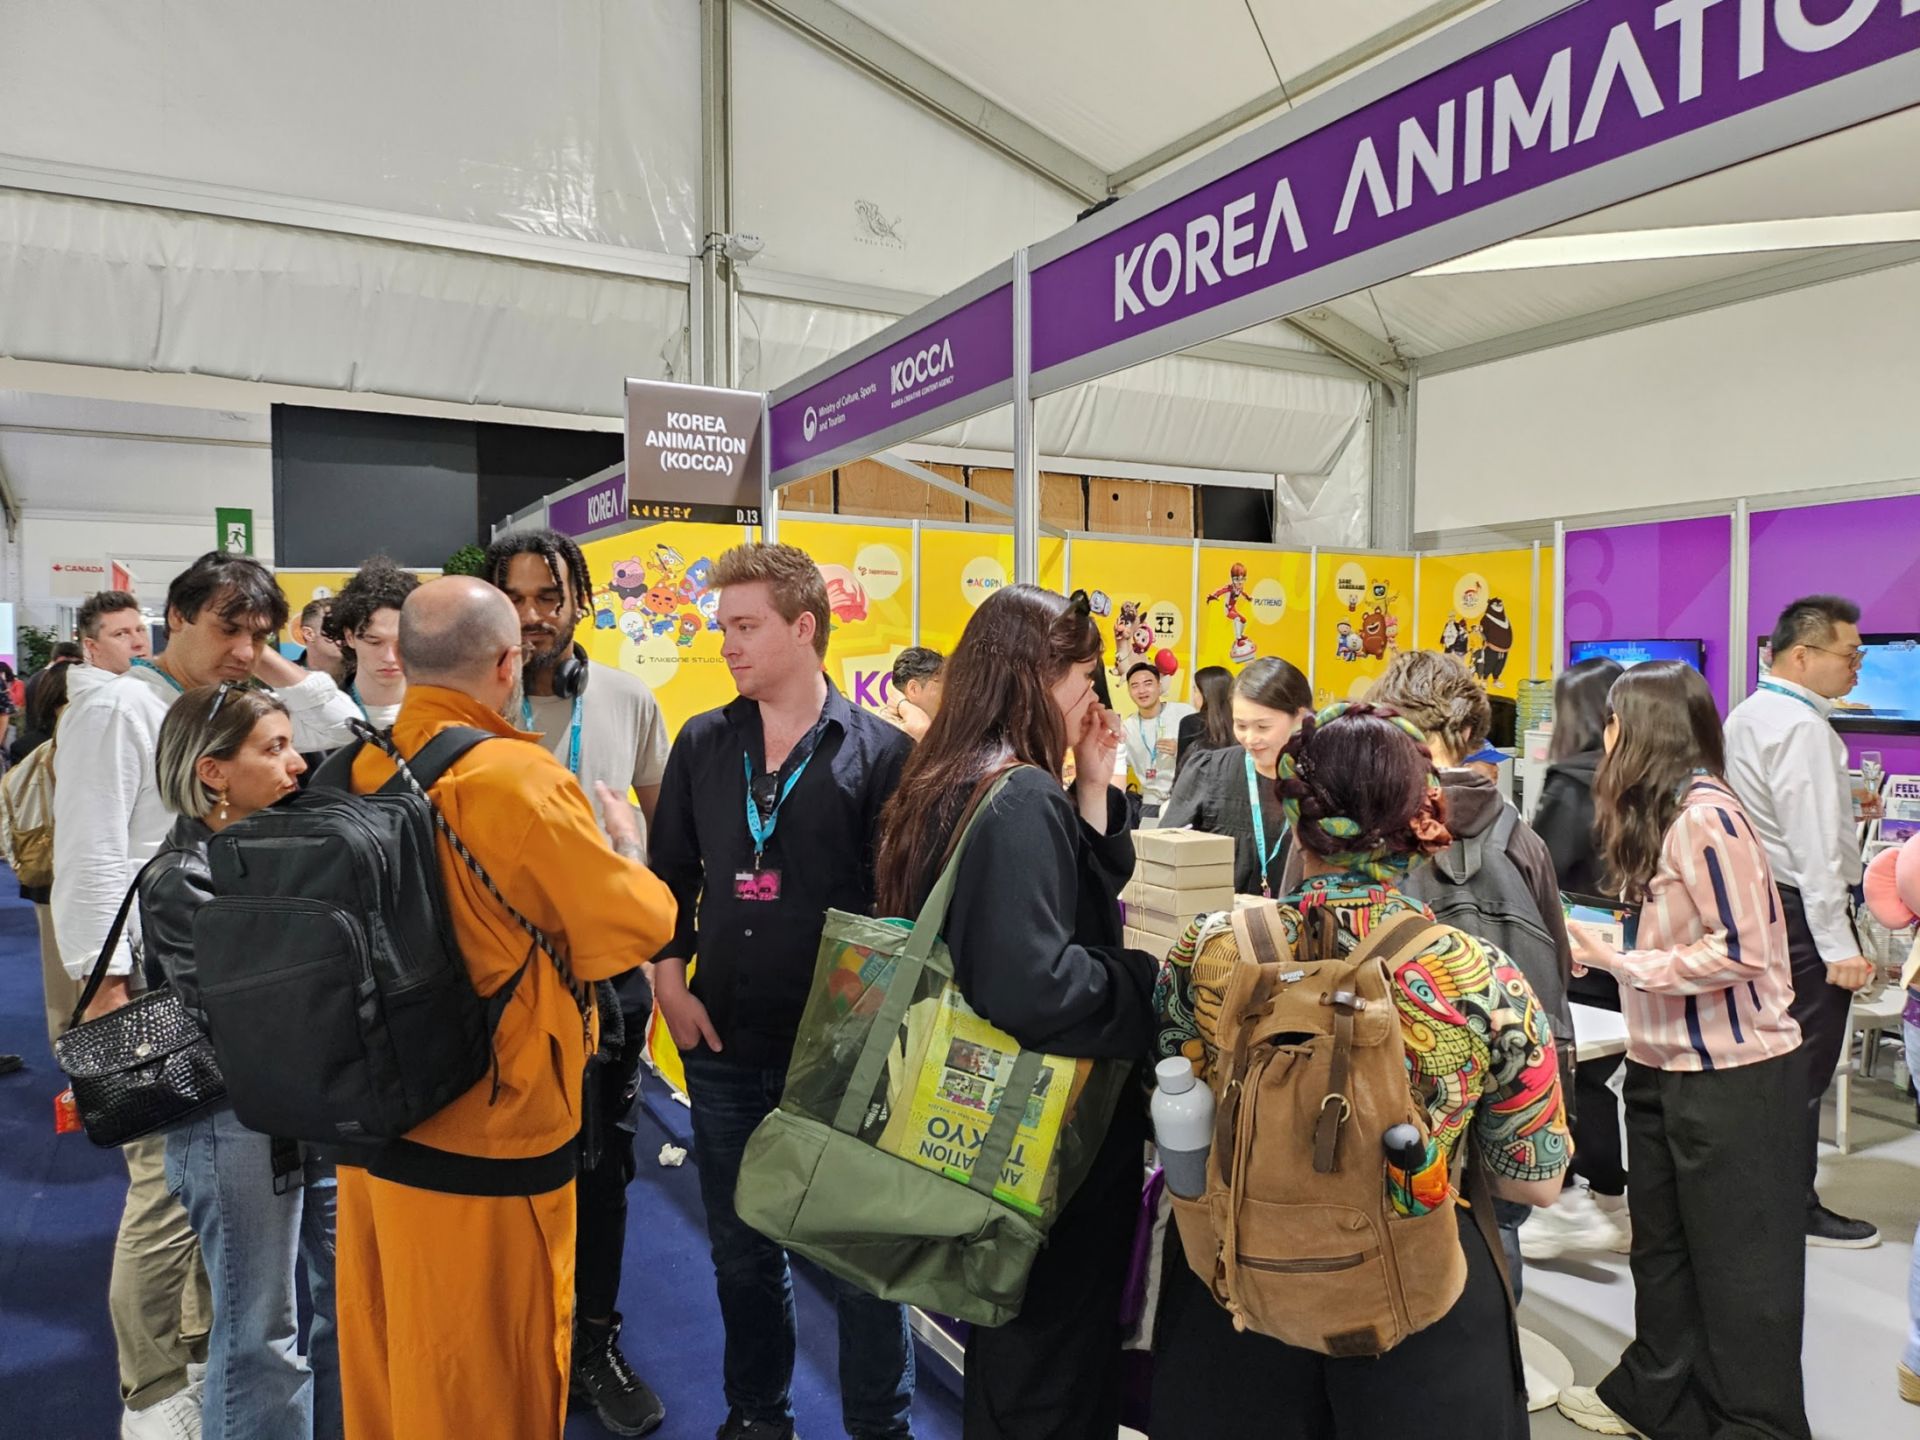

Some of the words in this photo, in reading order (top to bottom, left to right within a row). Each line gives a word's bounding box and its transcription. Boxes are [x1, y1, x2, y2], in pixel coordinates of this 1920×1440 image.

[1114, 177, 1308, 322] KOREA
[891, 338, 954, 395] KOCCA
[818, 401, 836, 417] Ministry
[836, 397, 842, 409] of
[860, 382, 877, 400] Sports
[667, 412, 727, 433] KOREA
[819, 421, 828, 432] and
[828, 413, 846, 428] Tourism
[645, 430, 747, 455] ANIMATION
[660, 451, 733, 476] (KOCCA)
[588, 488, 618, 525] KOREA
[736, 509, 759, 524] D.13
[64, 565, 104, 573] CANADA
[975, 577, 1002, 588] ACORN
[1895, 783, 1920, 793] FEEL
[927, 1116, 1025, 1167] TKYO
